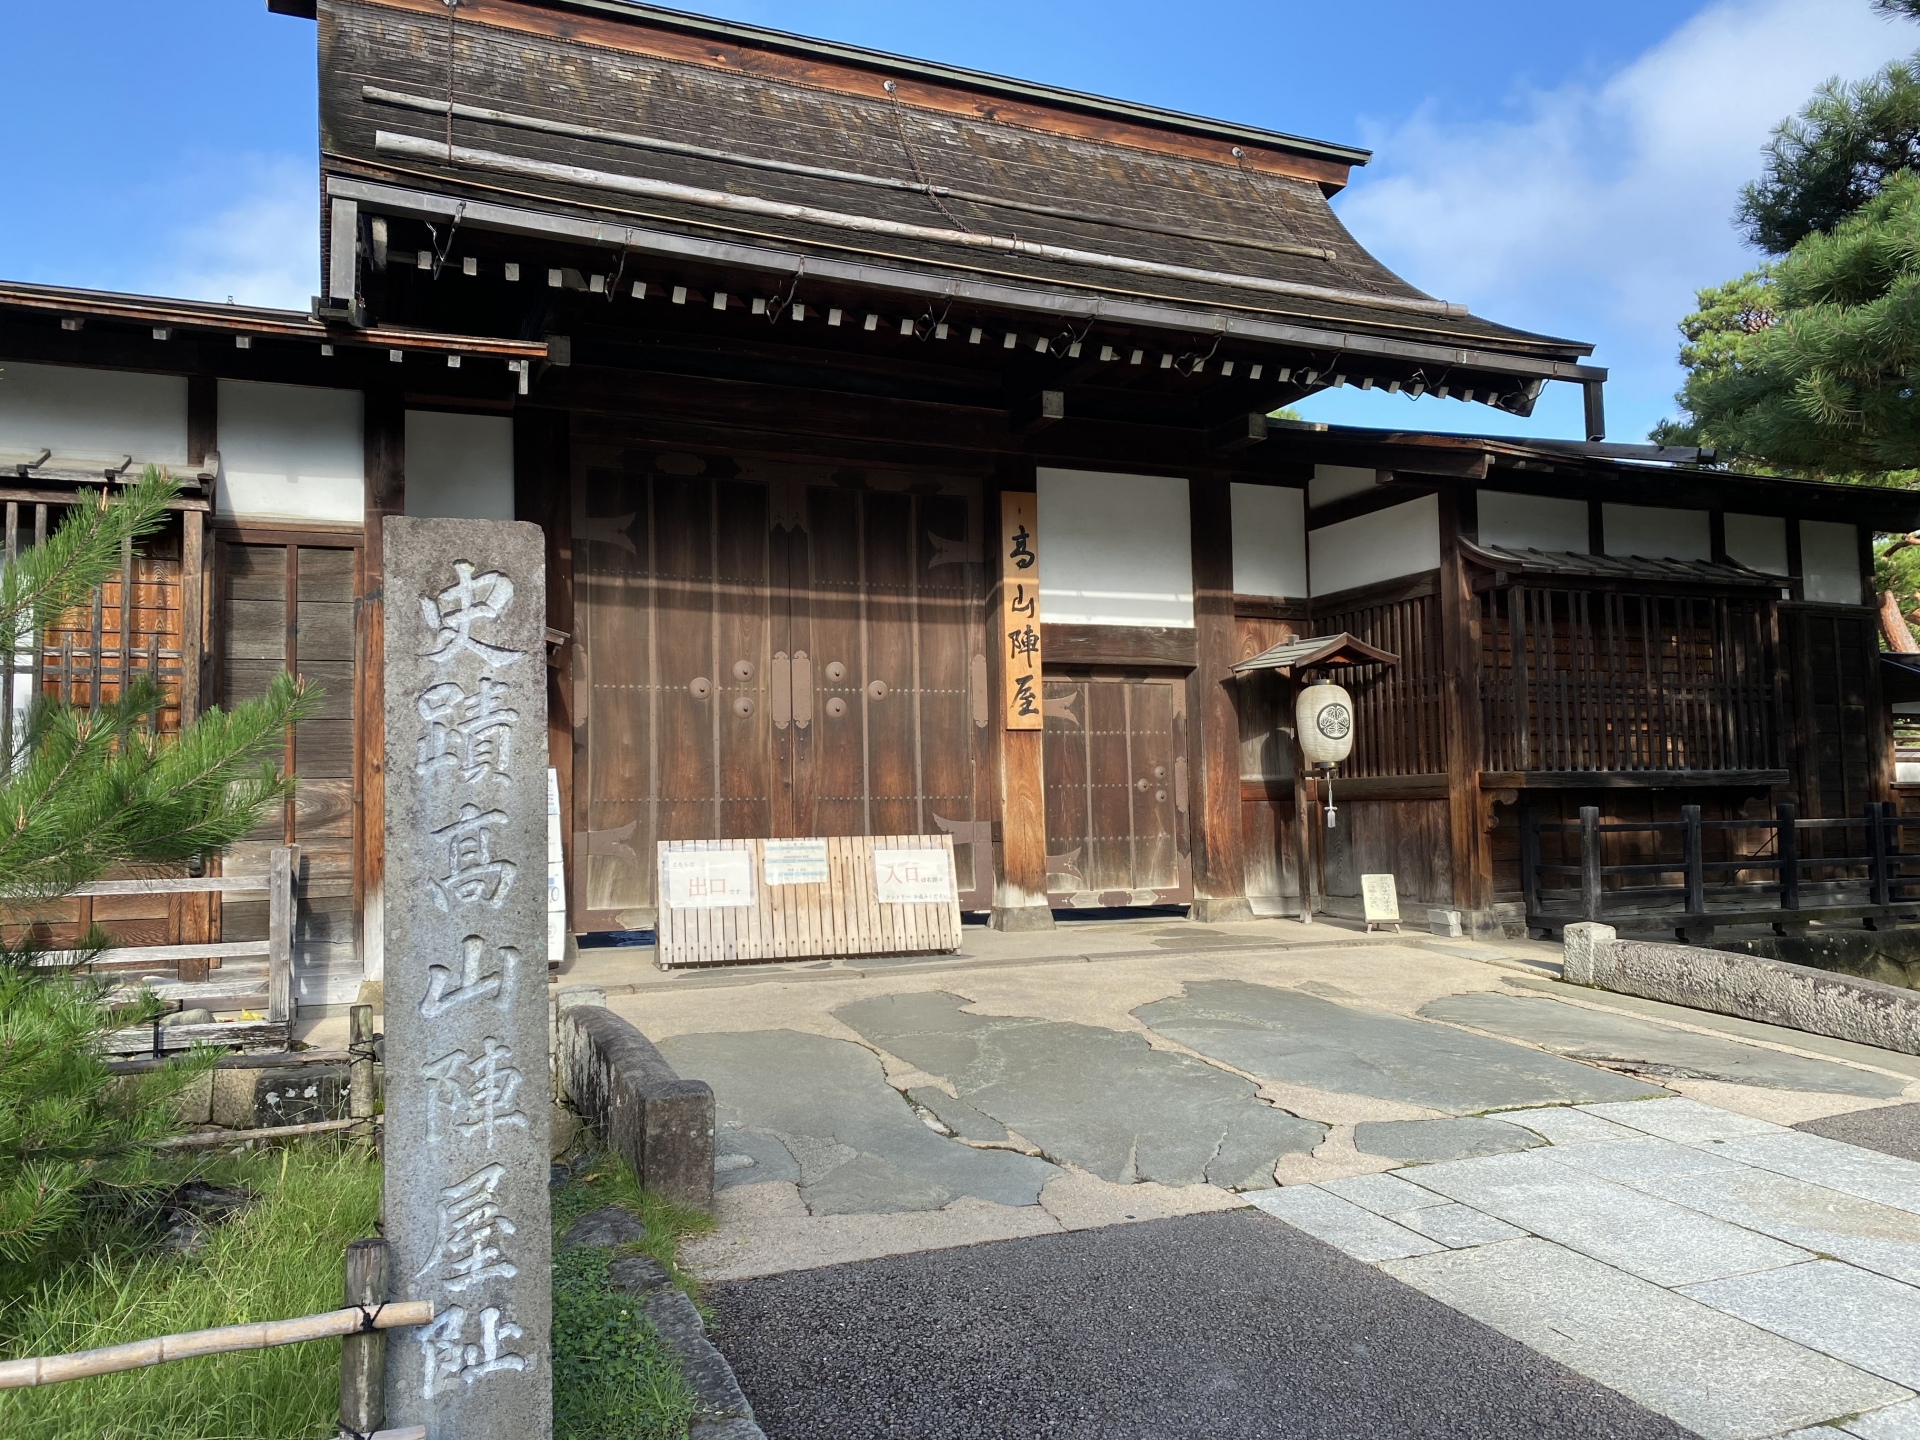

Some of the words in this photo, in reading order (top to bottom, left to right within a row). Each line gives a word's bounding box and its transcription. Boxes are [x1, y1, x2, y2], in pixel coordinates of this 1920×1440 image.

[1010, 525, 1040, 716] 高山陣屋
[884, 866, 919, 884] 入口
[688, 876, 726, 897] 出口
